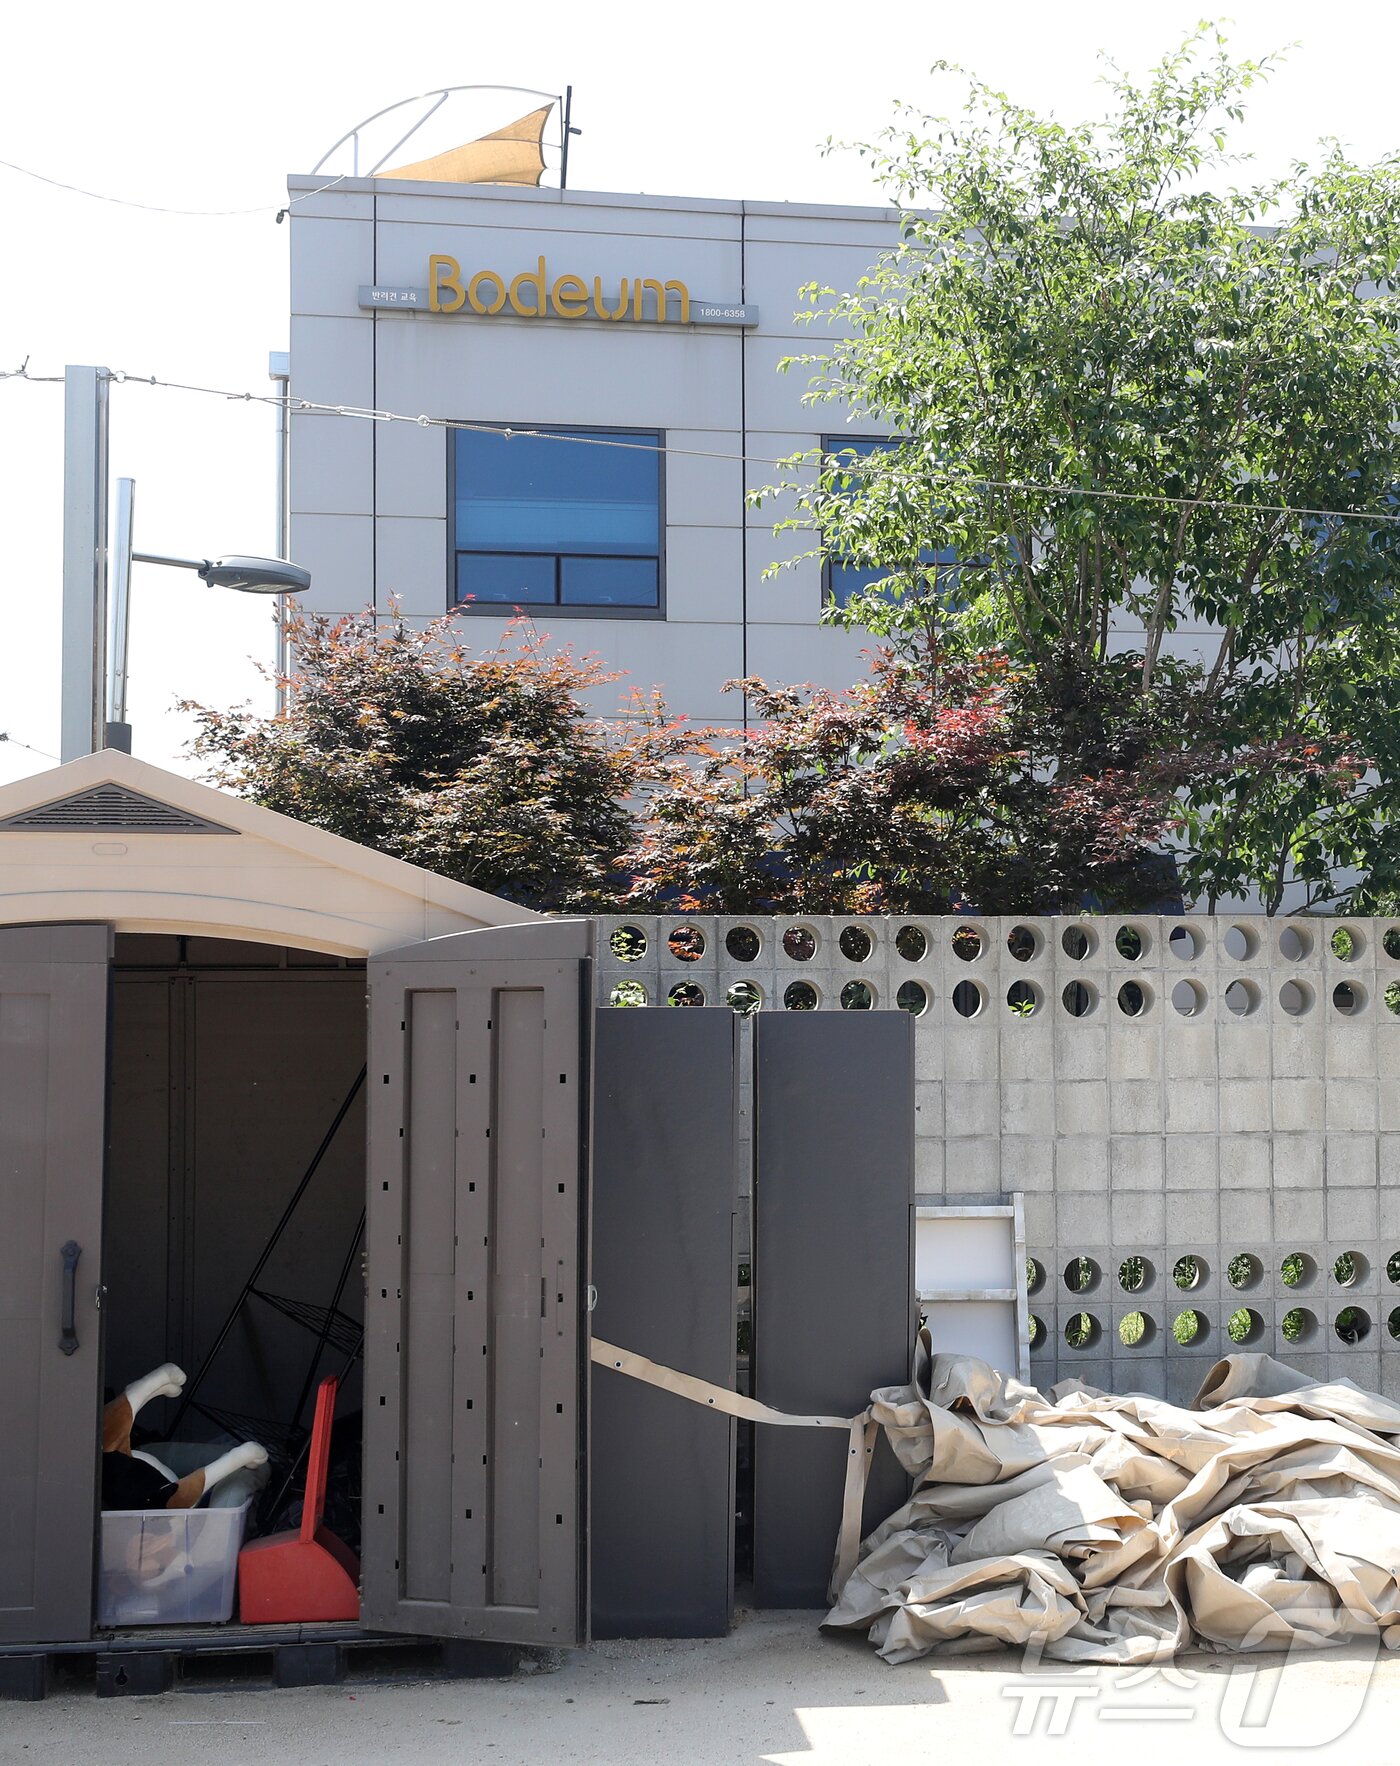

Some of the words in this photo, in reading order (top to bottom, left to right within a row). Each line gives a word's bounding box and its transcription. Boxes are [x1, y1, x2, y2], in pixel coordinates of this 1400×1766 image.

[429, 254, 690, 324] Bodeum
[372, 291, 397, 302] 반려견
[400, 292, 417, 303] 교육
[701, 308, 746, 318] 1800-6358
